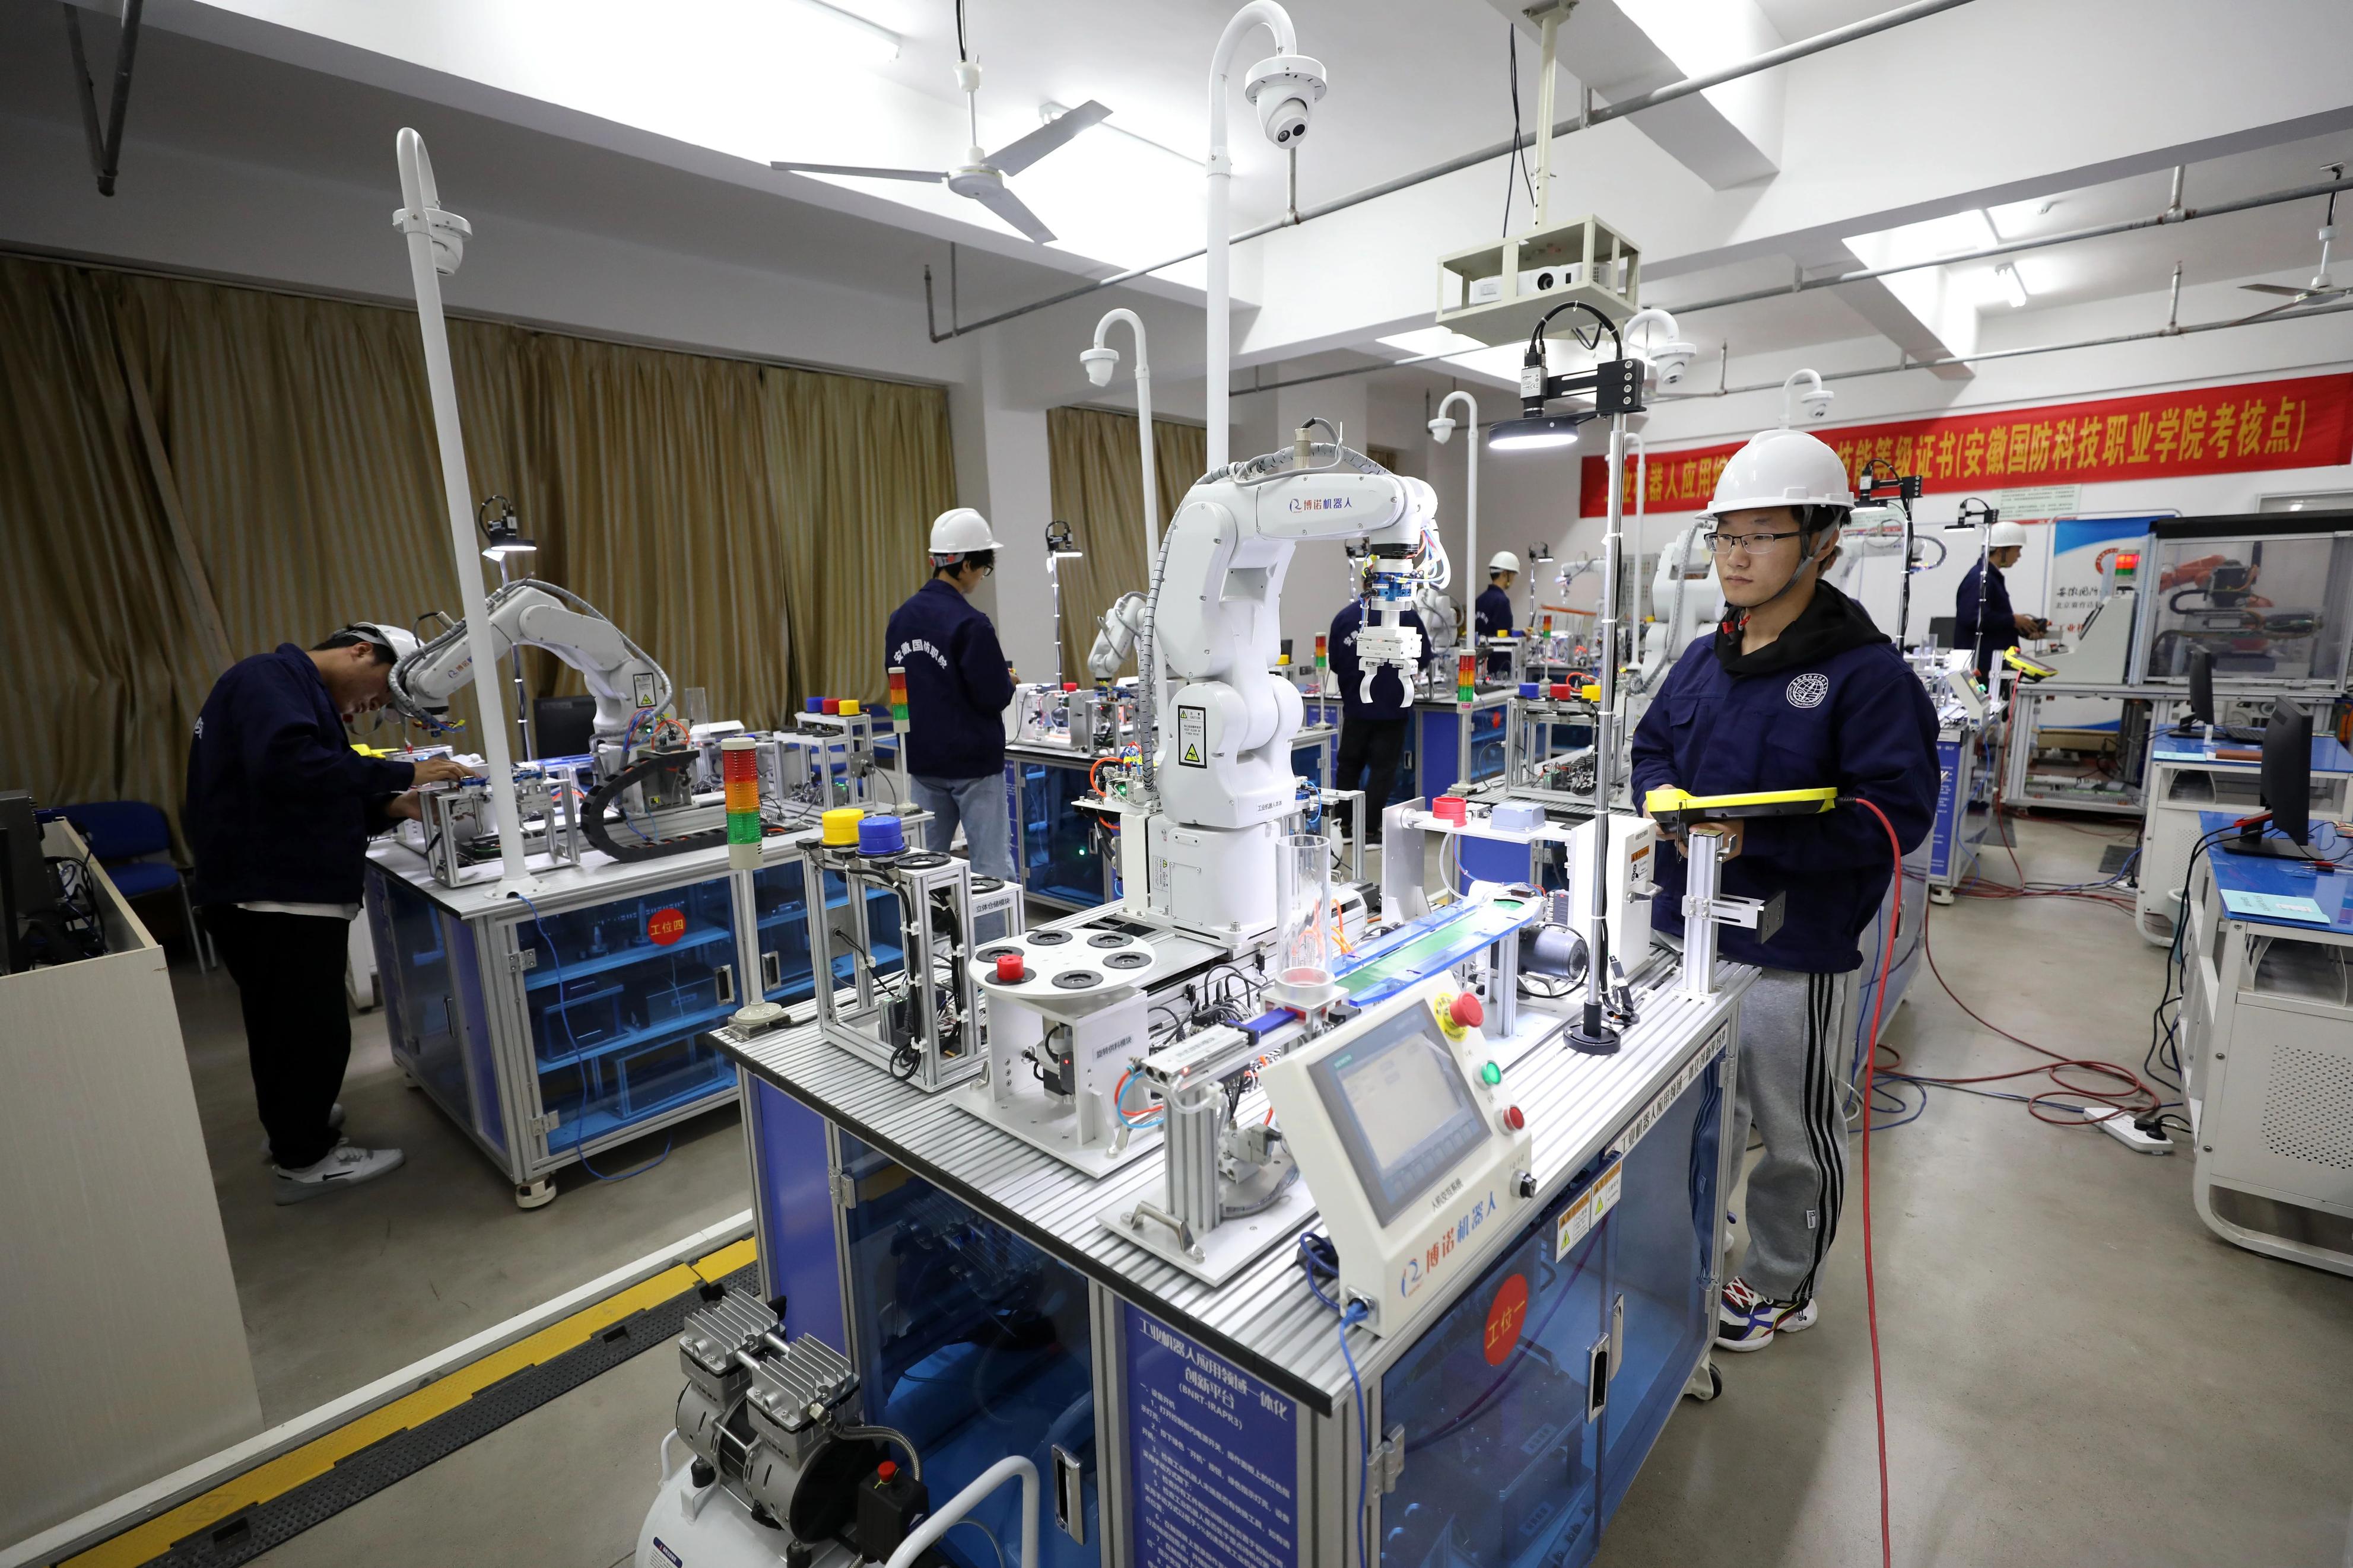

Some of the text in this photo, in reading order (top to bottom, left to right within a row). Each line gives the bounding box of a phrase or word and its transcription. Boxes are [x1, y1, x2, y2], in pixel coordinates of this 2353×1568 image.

[1304, 497, 1352, 510] 博诺机器人
[894, 639, 947, 669] 安徽国防职院
[976, 898, 1010, 912] 立体仓储模块
[650, 919, 684, 936] 工位四
[1097, 1036, 1132, 1059] 旋转供料模块
[1621, 1035, 1722, 1153] 工业机器人应用领域一体化创新平台
[1431, 1178, 1463, 1212] 人机交互系统
[1427, 1191, 1497, 1274] 博诺机器人
[1487, 1300, 1525, 1349] 工位一
[1139, 1317, 1288, 1421] 工业机器人应用领域一体化
[1179, 1383, 1243, 1431] (BNRT-IRAPR3)
[1185, 1367, 1235, 1410] 创新平台
